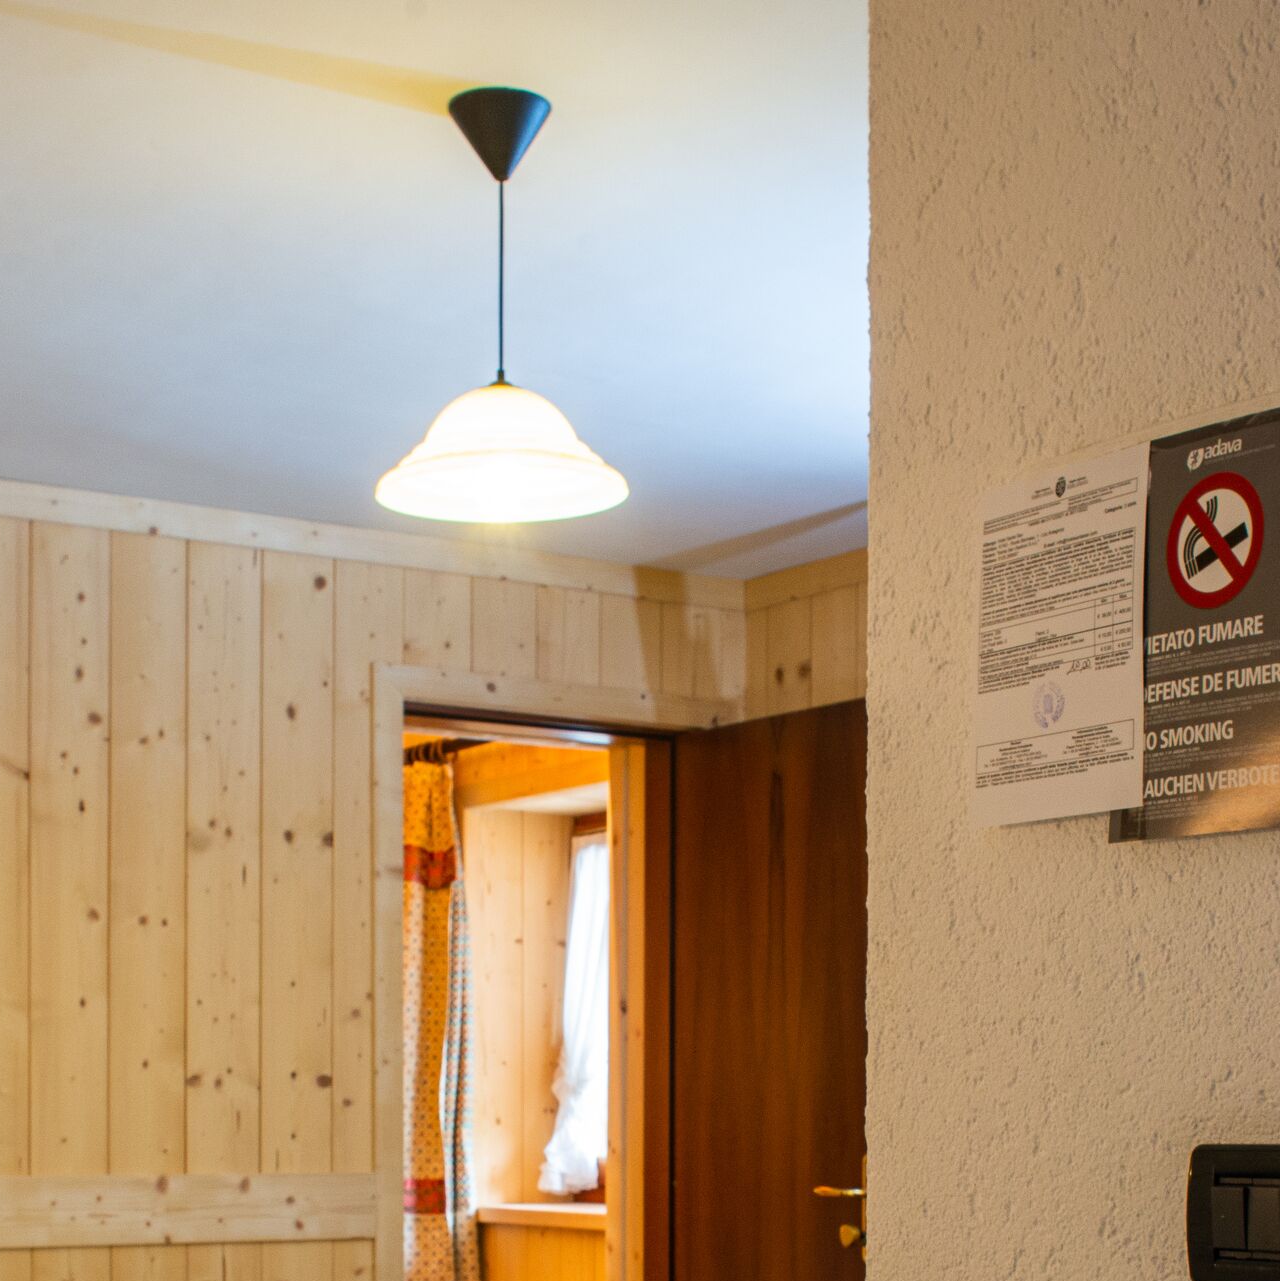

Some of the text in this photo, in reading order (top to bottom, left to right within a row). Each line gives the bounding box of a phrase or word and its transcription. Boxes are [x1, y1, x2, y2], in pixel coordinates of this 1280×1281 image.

[1204, 438, 1242, 459] adava
[1198, 614, 1264, 644] FUMARE
[1202, 672, 1223, 694] DE
[1160, 719, 1234, 749] SMOKING
[1144, 772, 1204, 799] AUCHEN
